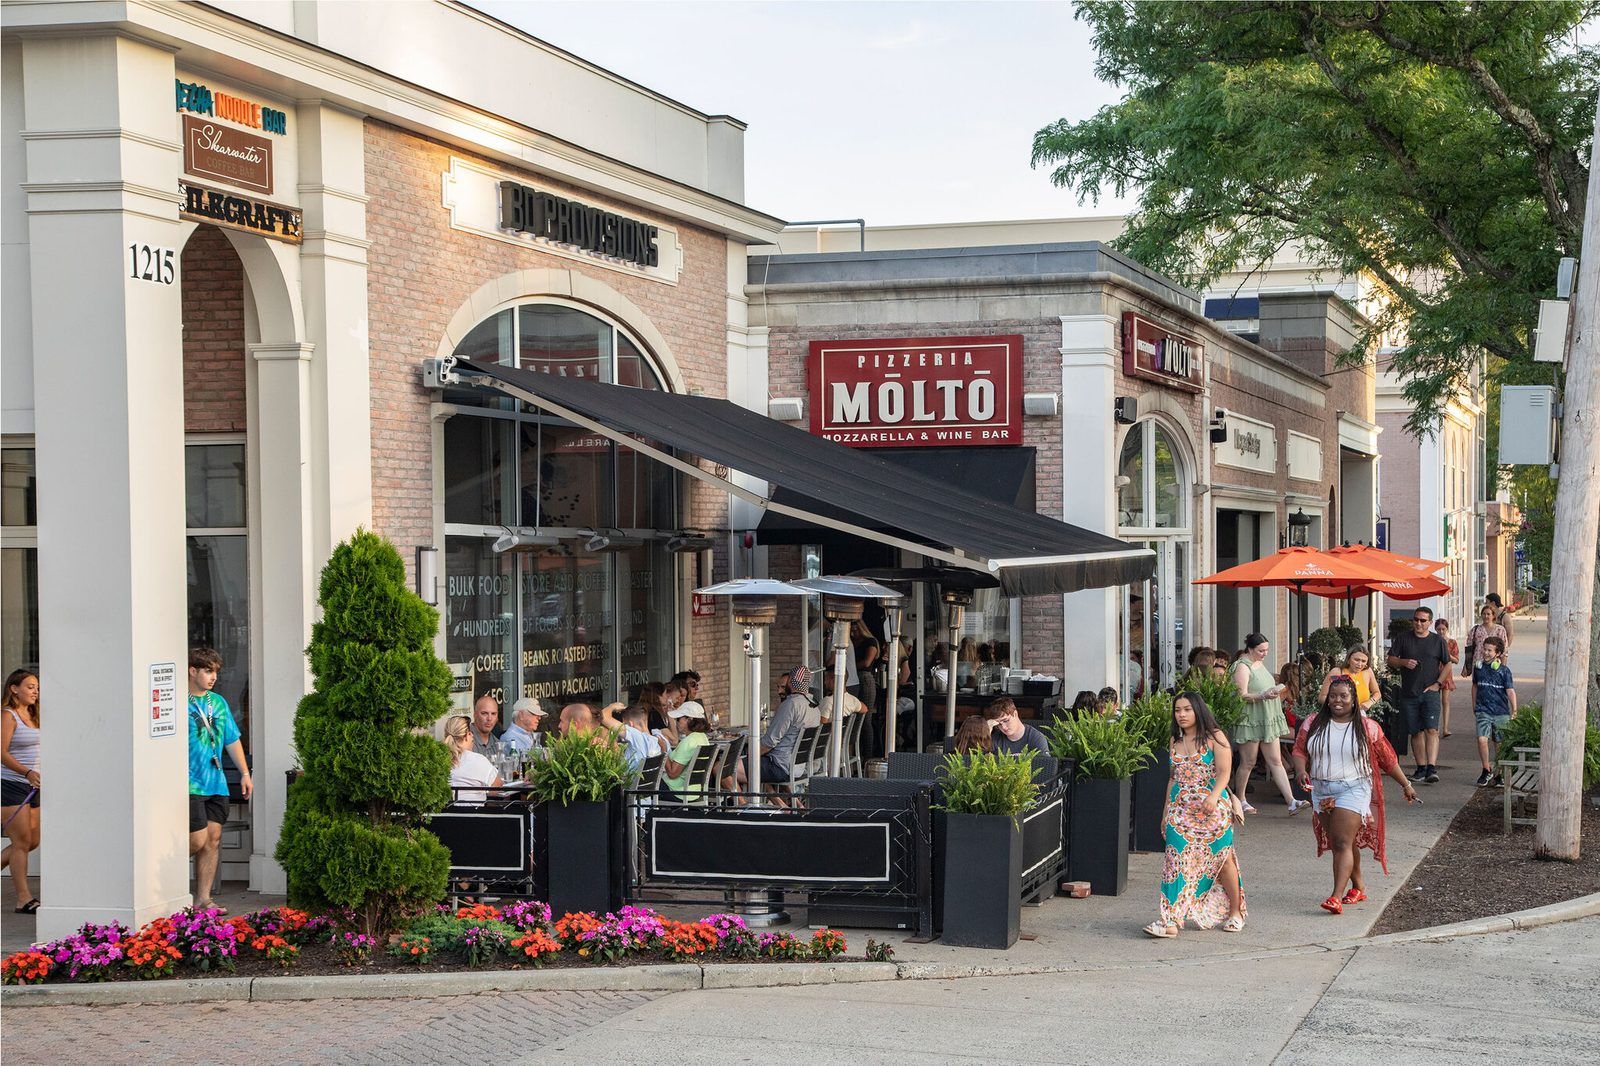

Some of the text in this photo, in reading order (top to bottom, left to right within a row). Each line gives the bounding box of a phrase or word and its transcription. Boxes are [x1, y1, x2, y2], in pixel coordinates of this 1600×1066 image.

[215, 92, 262, 129] NOODLE
[262, 107, 287, 136] BAR
[198, 125, 262, 164] Shearwater
[179, 184, 292, 236] ILKCRAFT
[500, 181, 659, 268] BD PROVISIONS
[128, 243, 175, 285] 1215
[857, 352, 973, 369] PIZZERIA
[822, 430, 1009, 442] MOZZARELLA & WINE BAR
[449, 575, 475, 597] BULK
[478, 575, 511, 596] FOOD
[521, 573, 551, 595] STORE
[621, 571, 653, 589] OASTER
[463, 618, 511, 638] HUNDREDS
[522, 618, 535, 634] OF
[476, 653, 510, 672] COFFEE
[523, 649, 550, 668] BEANS
[551, 645, 586, 666] ROASTED
[491, 669, 650, 704] ECO FRIENDLY PACKAGING OPTIONS
